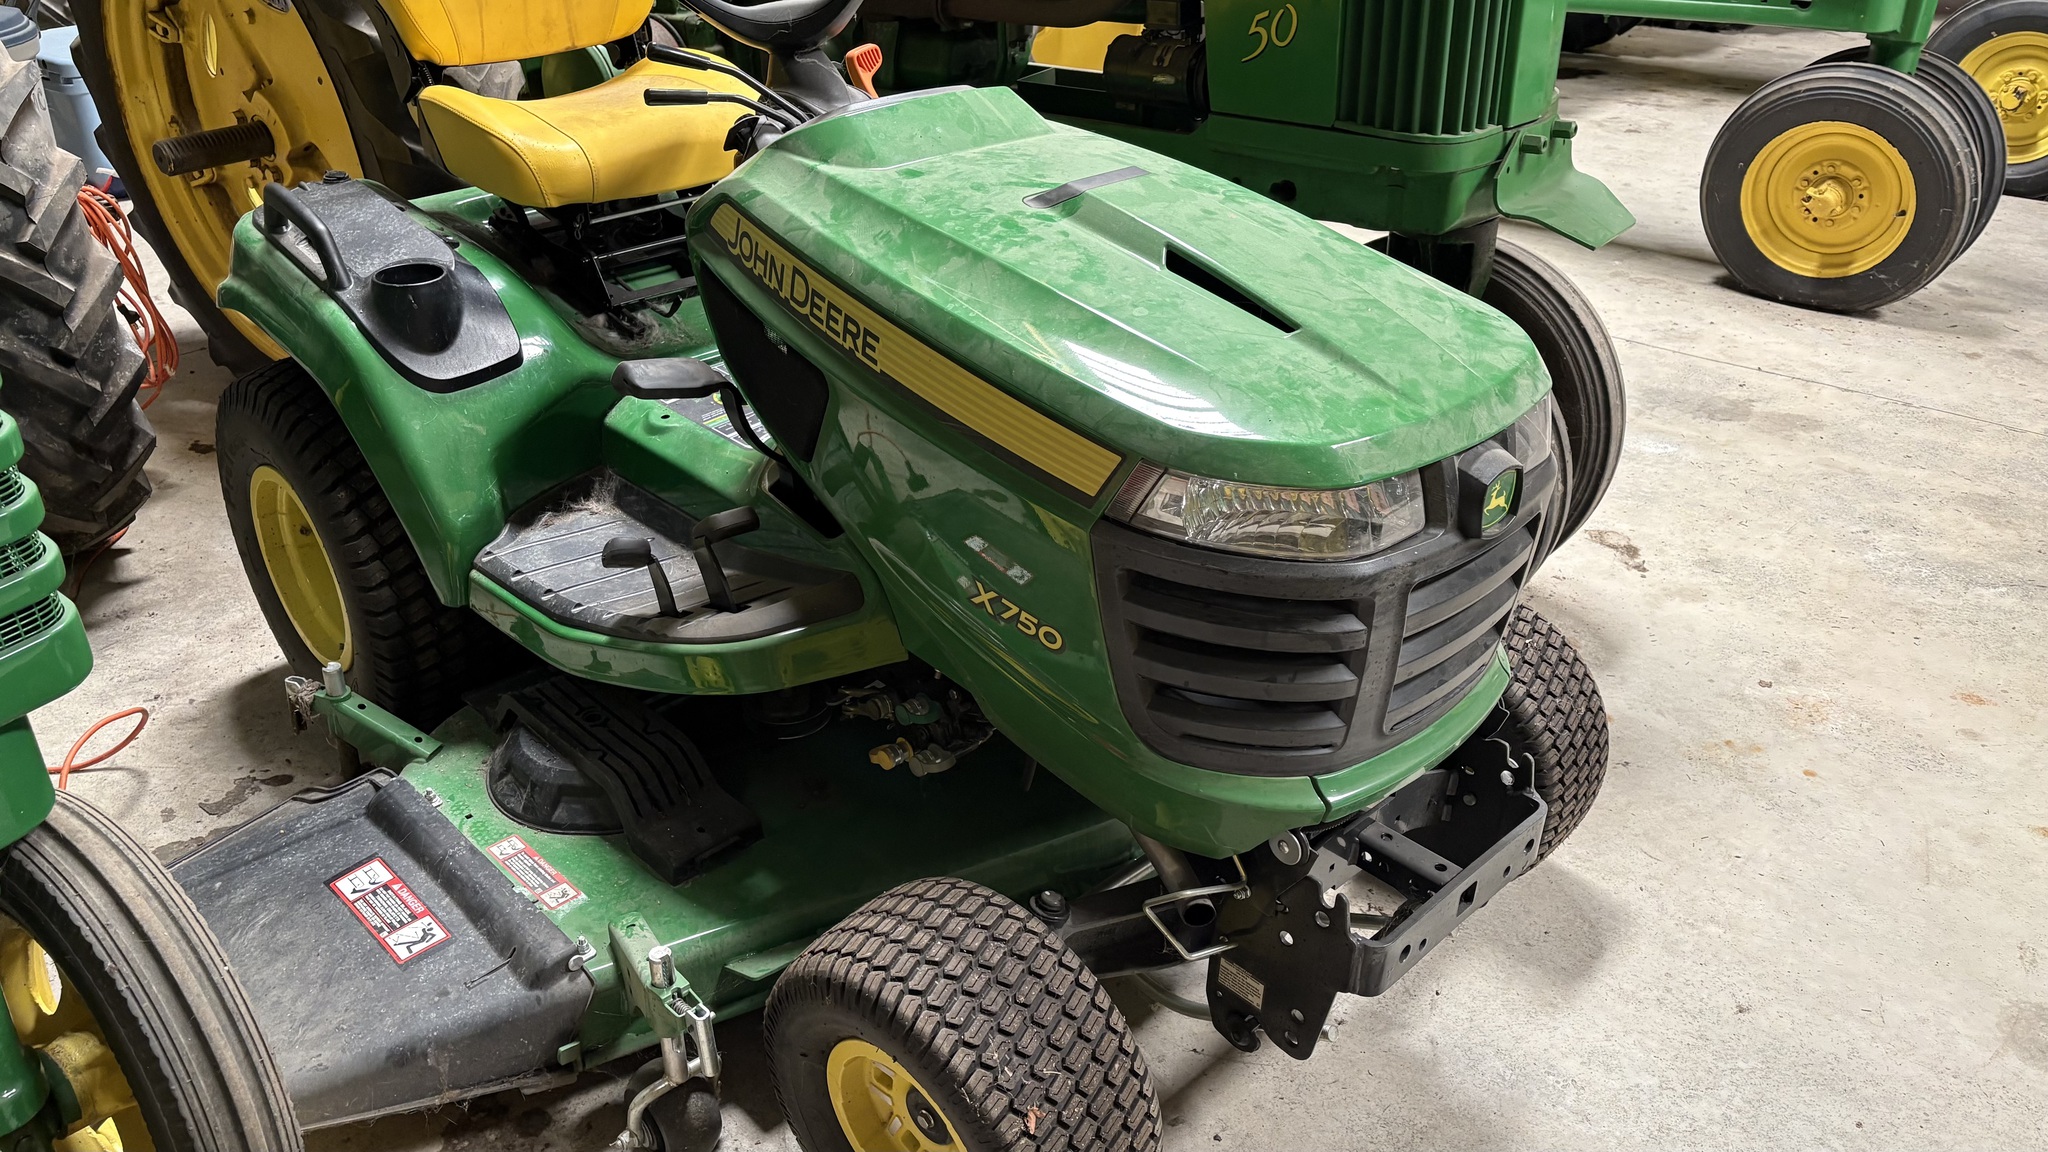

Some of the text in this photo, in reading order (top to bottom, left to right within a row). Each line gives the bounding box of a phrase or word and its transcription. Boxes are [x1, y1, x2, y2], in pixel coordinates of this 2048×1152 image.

[1241, 3, 1298, 62] 50
[727, 217, 880, 367] JOHN DEERE
[970, 580, 1063, 650] X750
[538, 858, 557, 876] DANGER
[399, 888, 425, 914] DANGER
